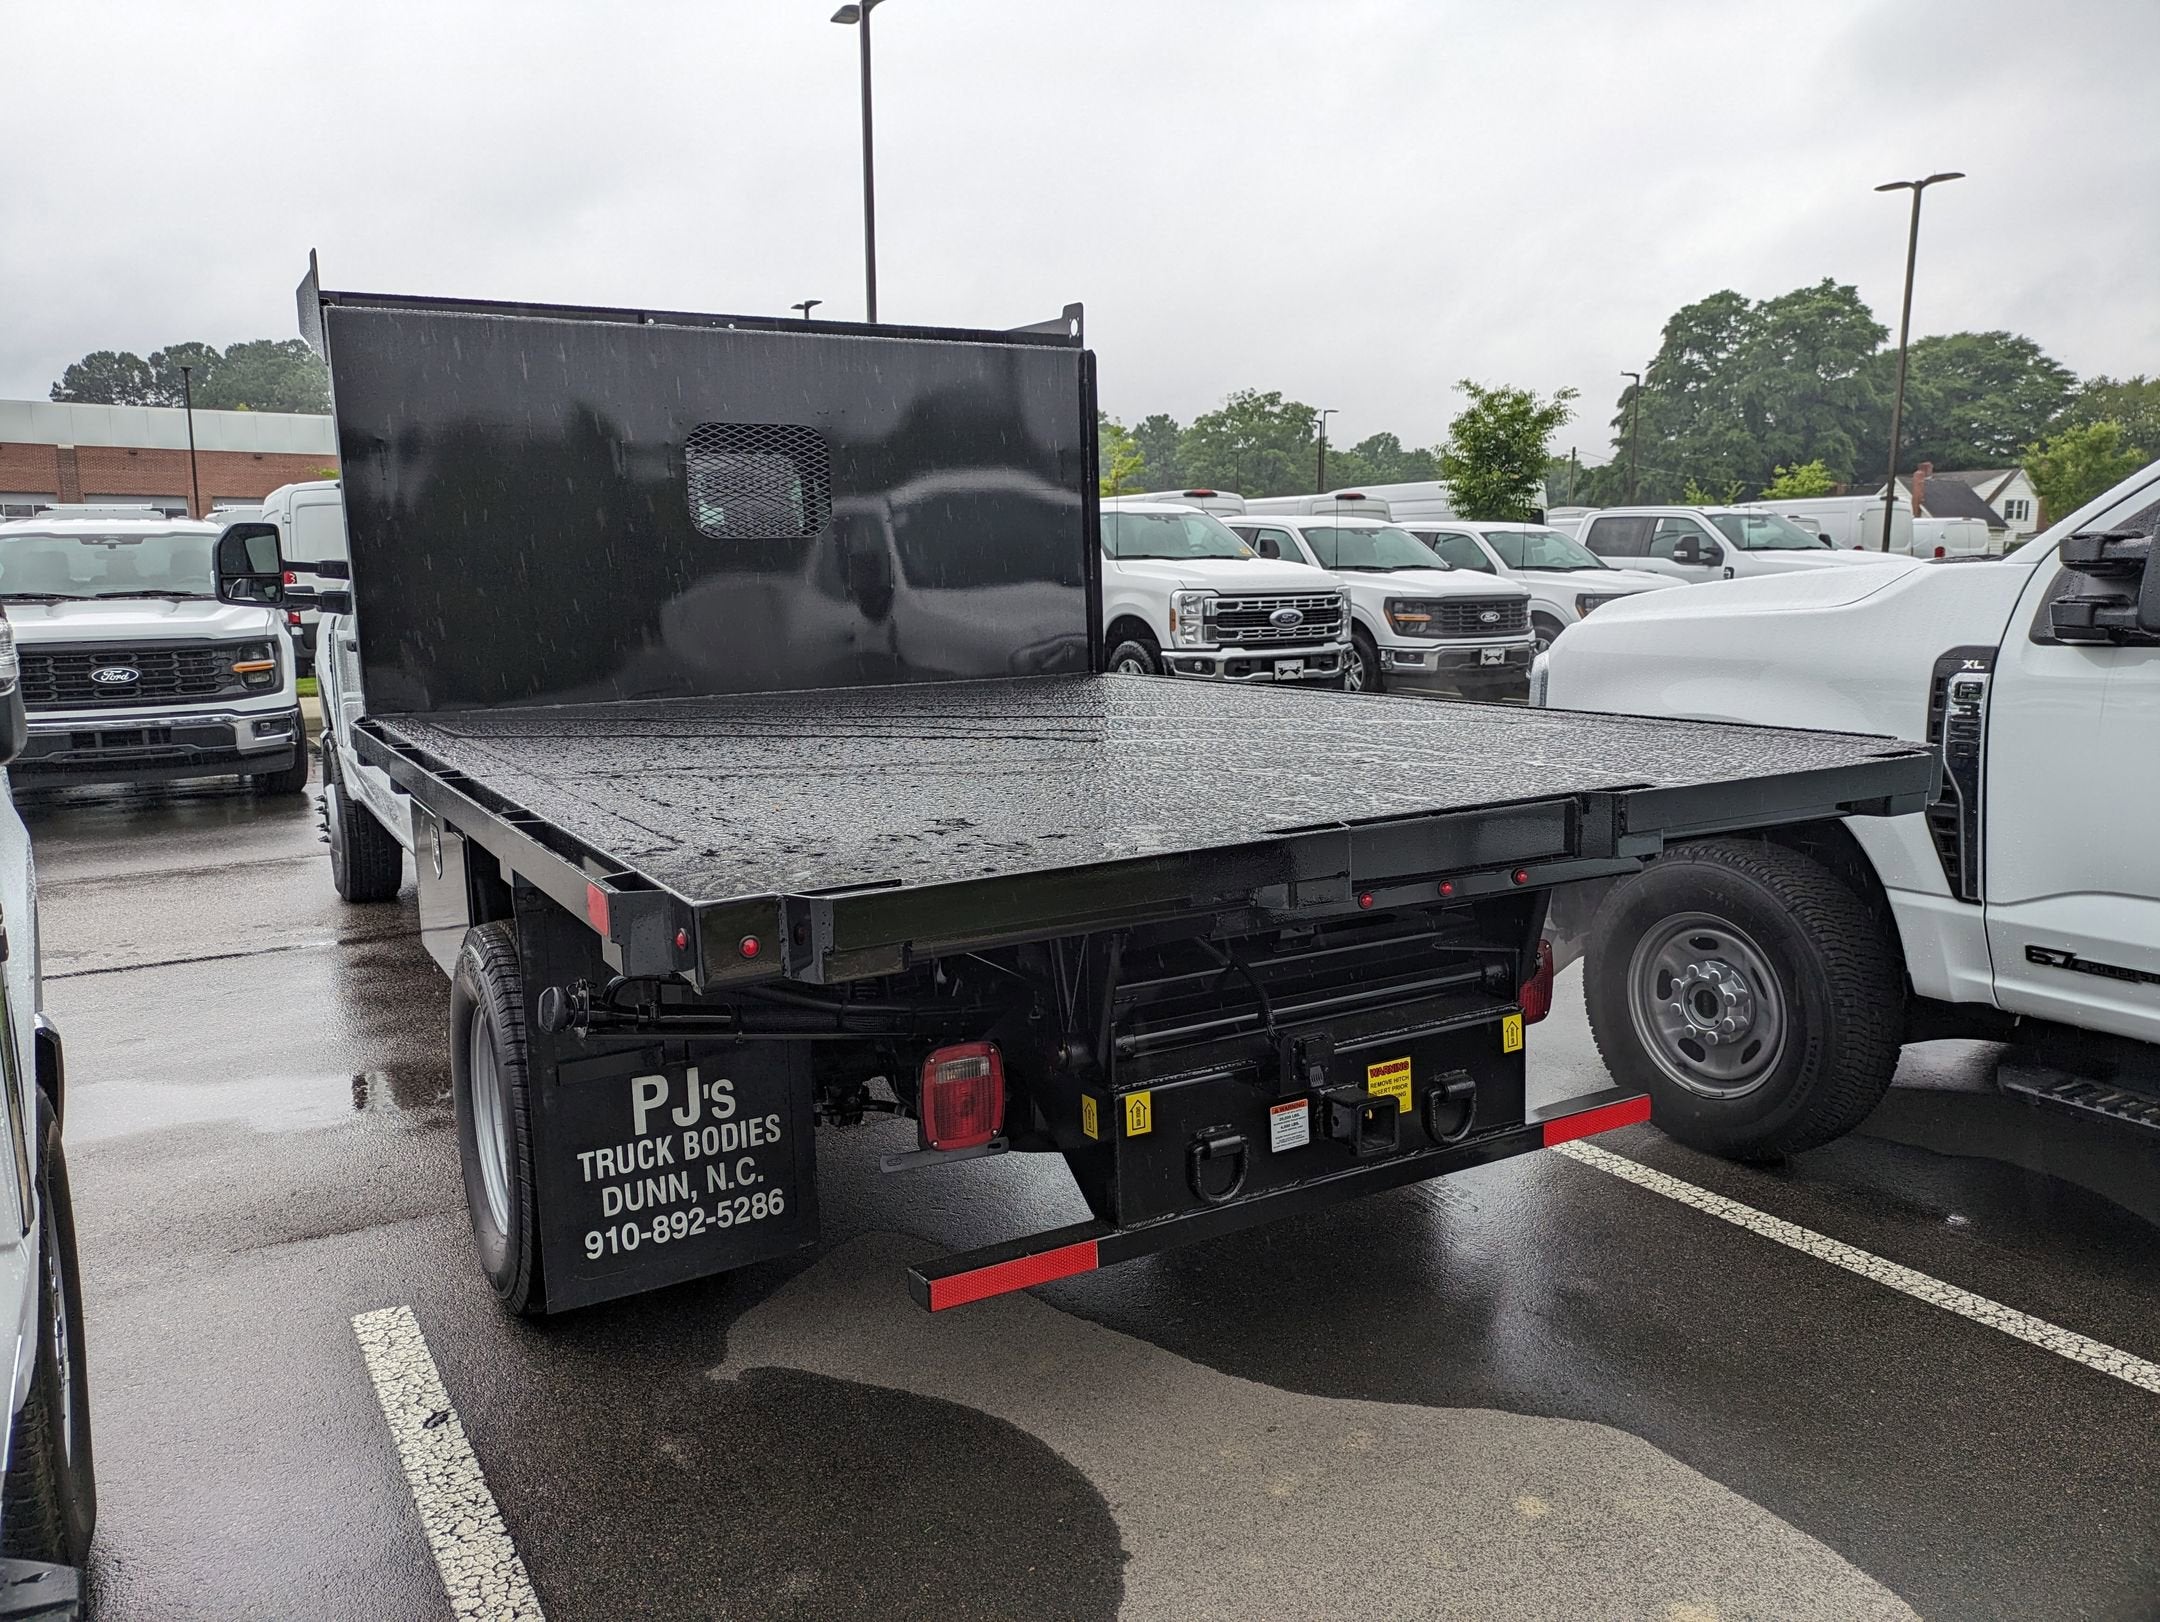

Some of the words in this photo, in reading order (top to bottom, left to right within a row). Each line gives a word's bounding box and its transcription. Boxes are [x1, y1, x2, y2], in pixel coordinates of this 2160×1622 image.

[1961, 659, 1985, 670] XL
[99, 669, 131, 681] Ford
[1370, 1061, 1409, 1078] WARNING
[1370, 1079, 1392, 1088] REMOVE
[1393, 1075, 1409, 1084] HITCH
[1392, 1083, 1408, 1092] PRIOR
[577, 1135, 674, 1182] TRUCK
[683, 1114, 781, 1160] BODIES
[602, 1171, 697, 1217] DUNN,
[706, 1157, 764, 1194] N.C.
[584, 1188, 785, 1260] 910-892-5286
